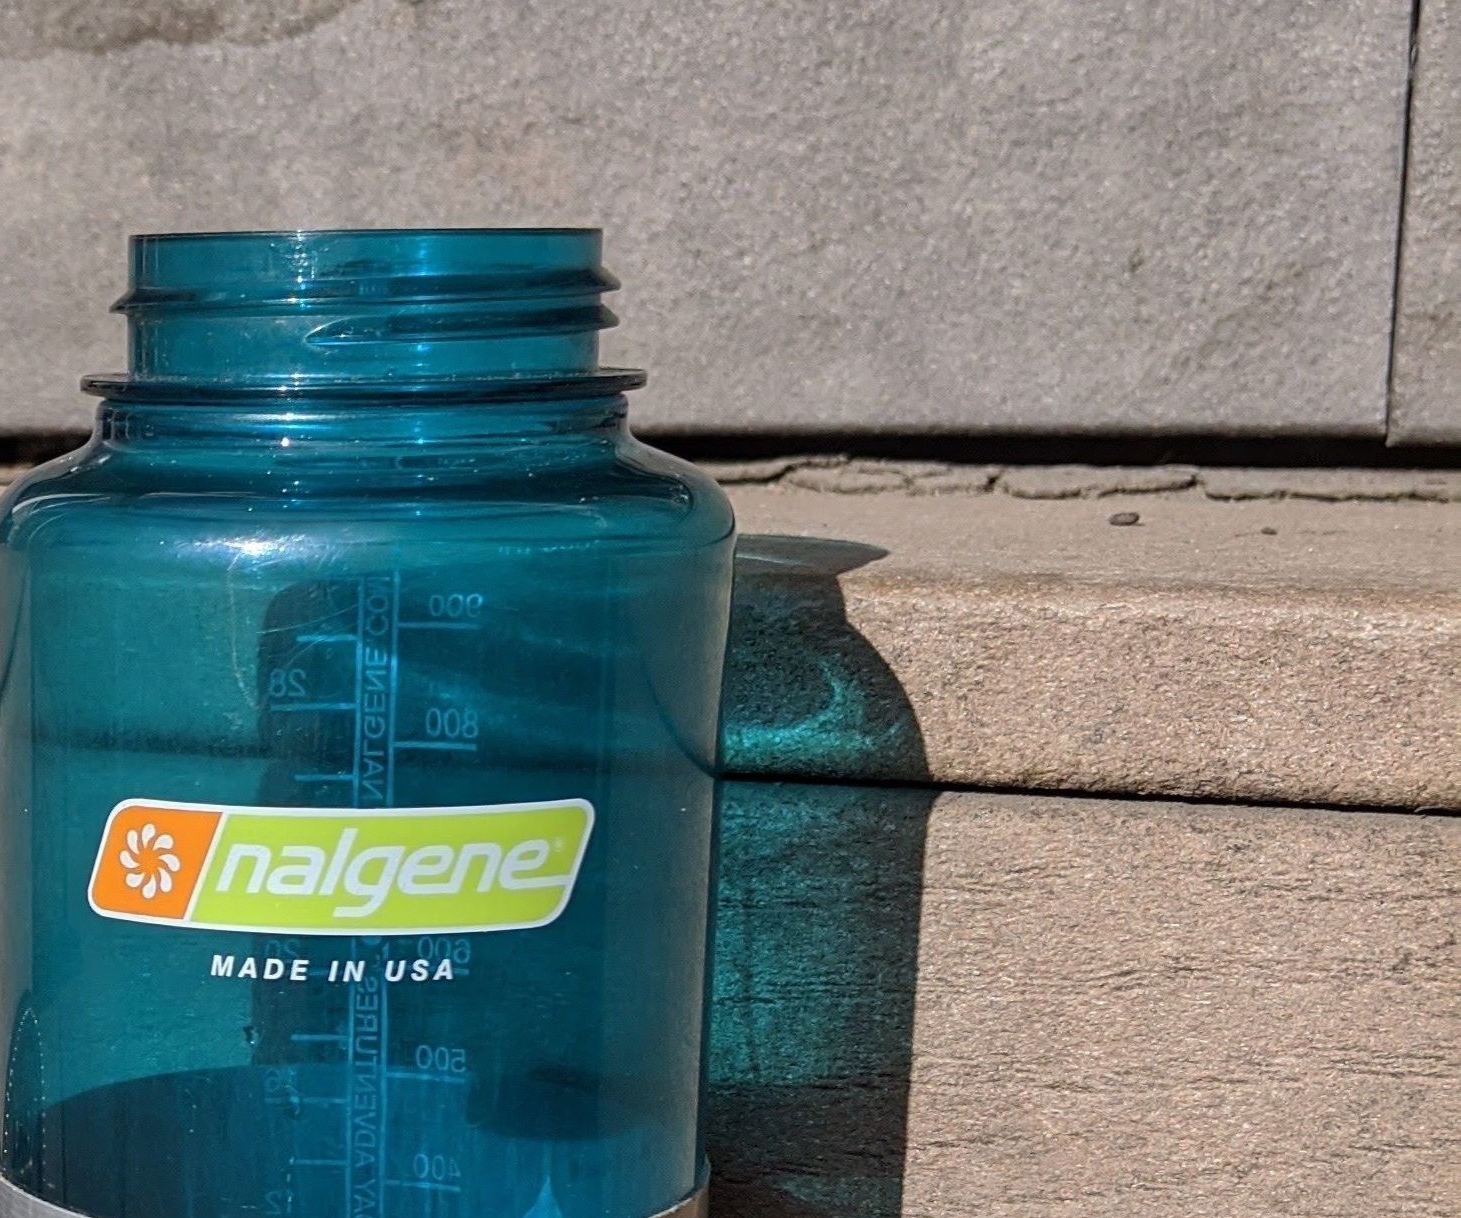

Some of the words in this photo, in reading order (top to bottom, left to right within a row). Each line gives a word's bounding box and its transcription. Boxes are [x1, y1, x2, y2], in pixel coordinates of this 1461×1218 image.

[215, 827, 574, 919] nalgene
[210, 954, 310, 981] MADE
[327, 959, 365, 982] IN
[384, 957, 454, 982] USA
